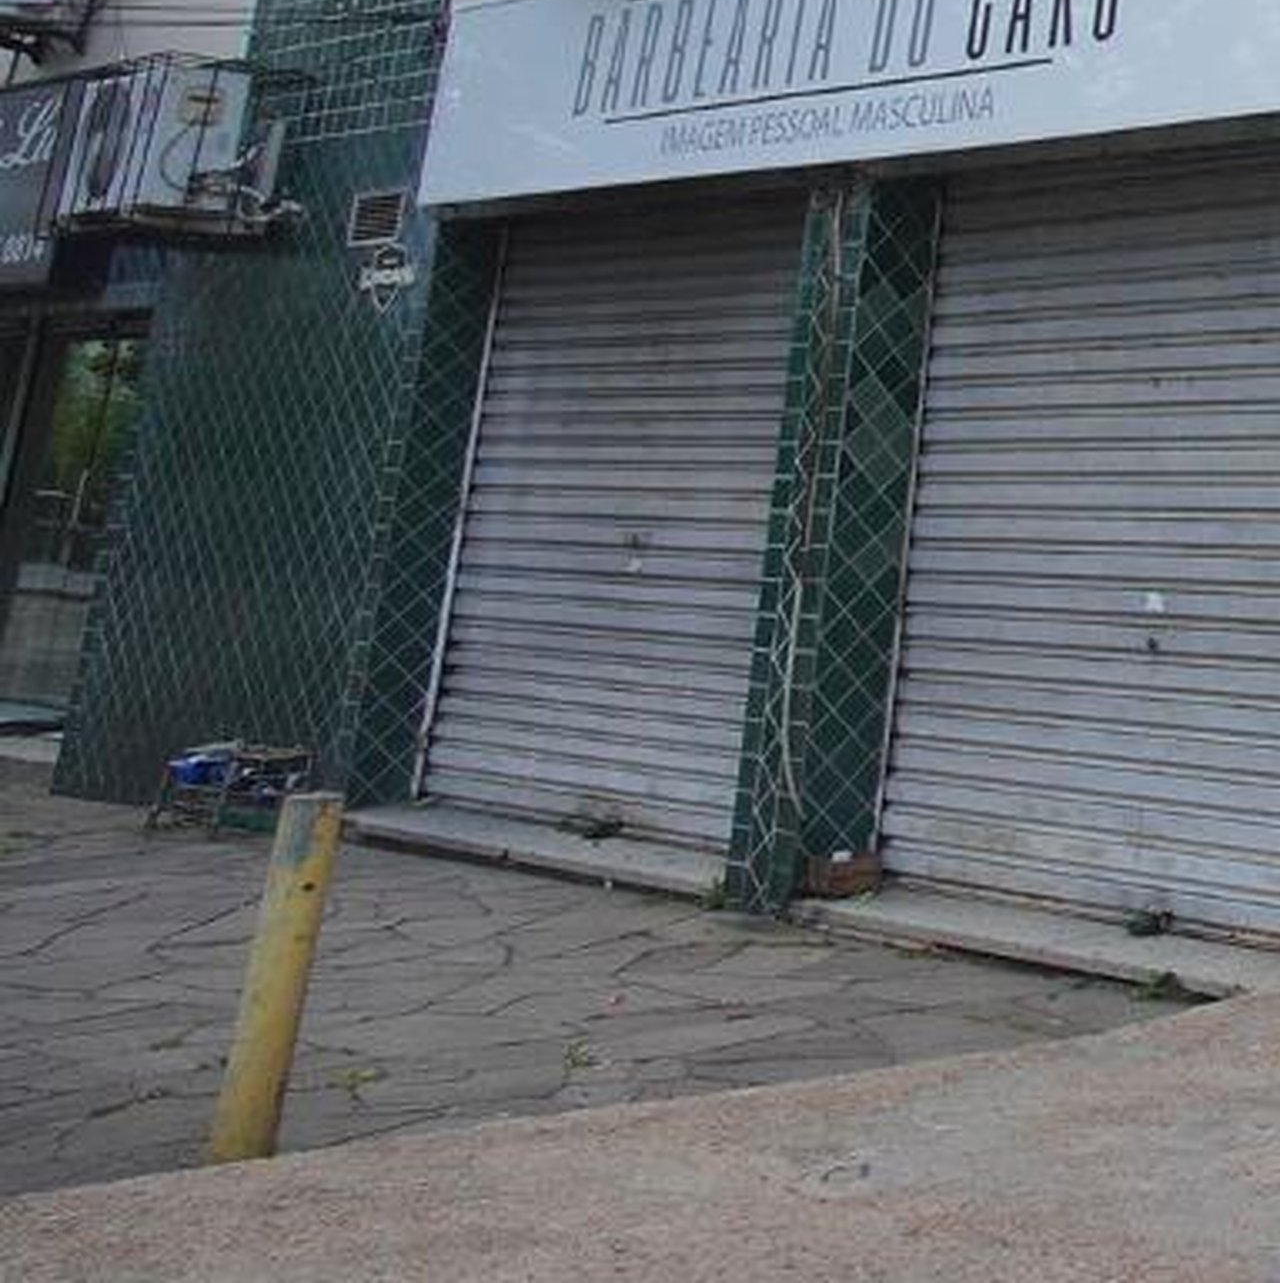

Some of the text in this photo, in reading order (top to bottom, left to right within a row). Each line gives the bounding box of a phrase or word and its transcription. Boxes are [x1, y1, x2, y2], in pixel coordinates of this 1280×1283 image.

[659, 85, 995, 158] IMAGEM PESSOAL MASCULINA
